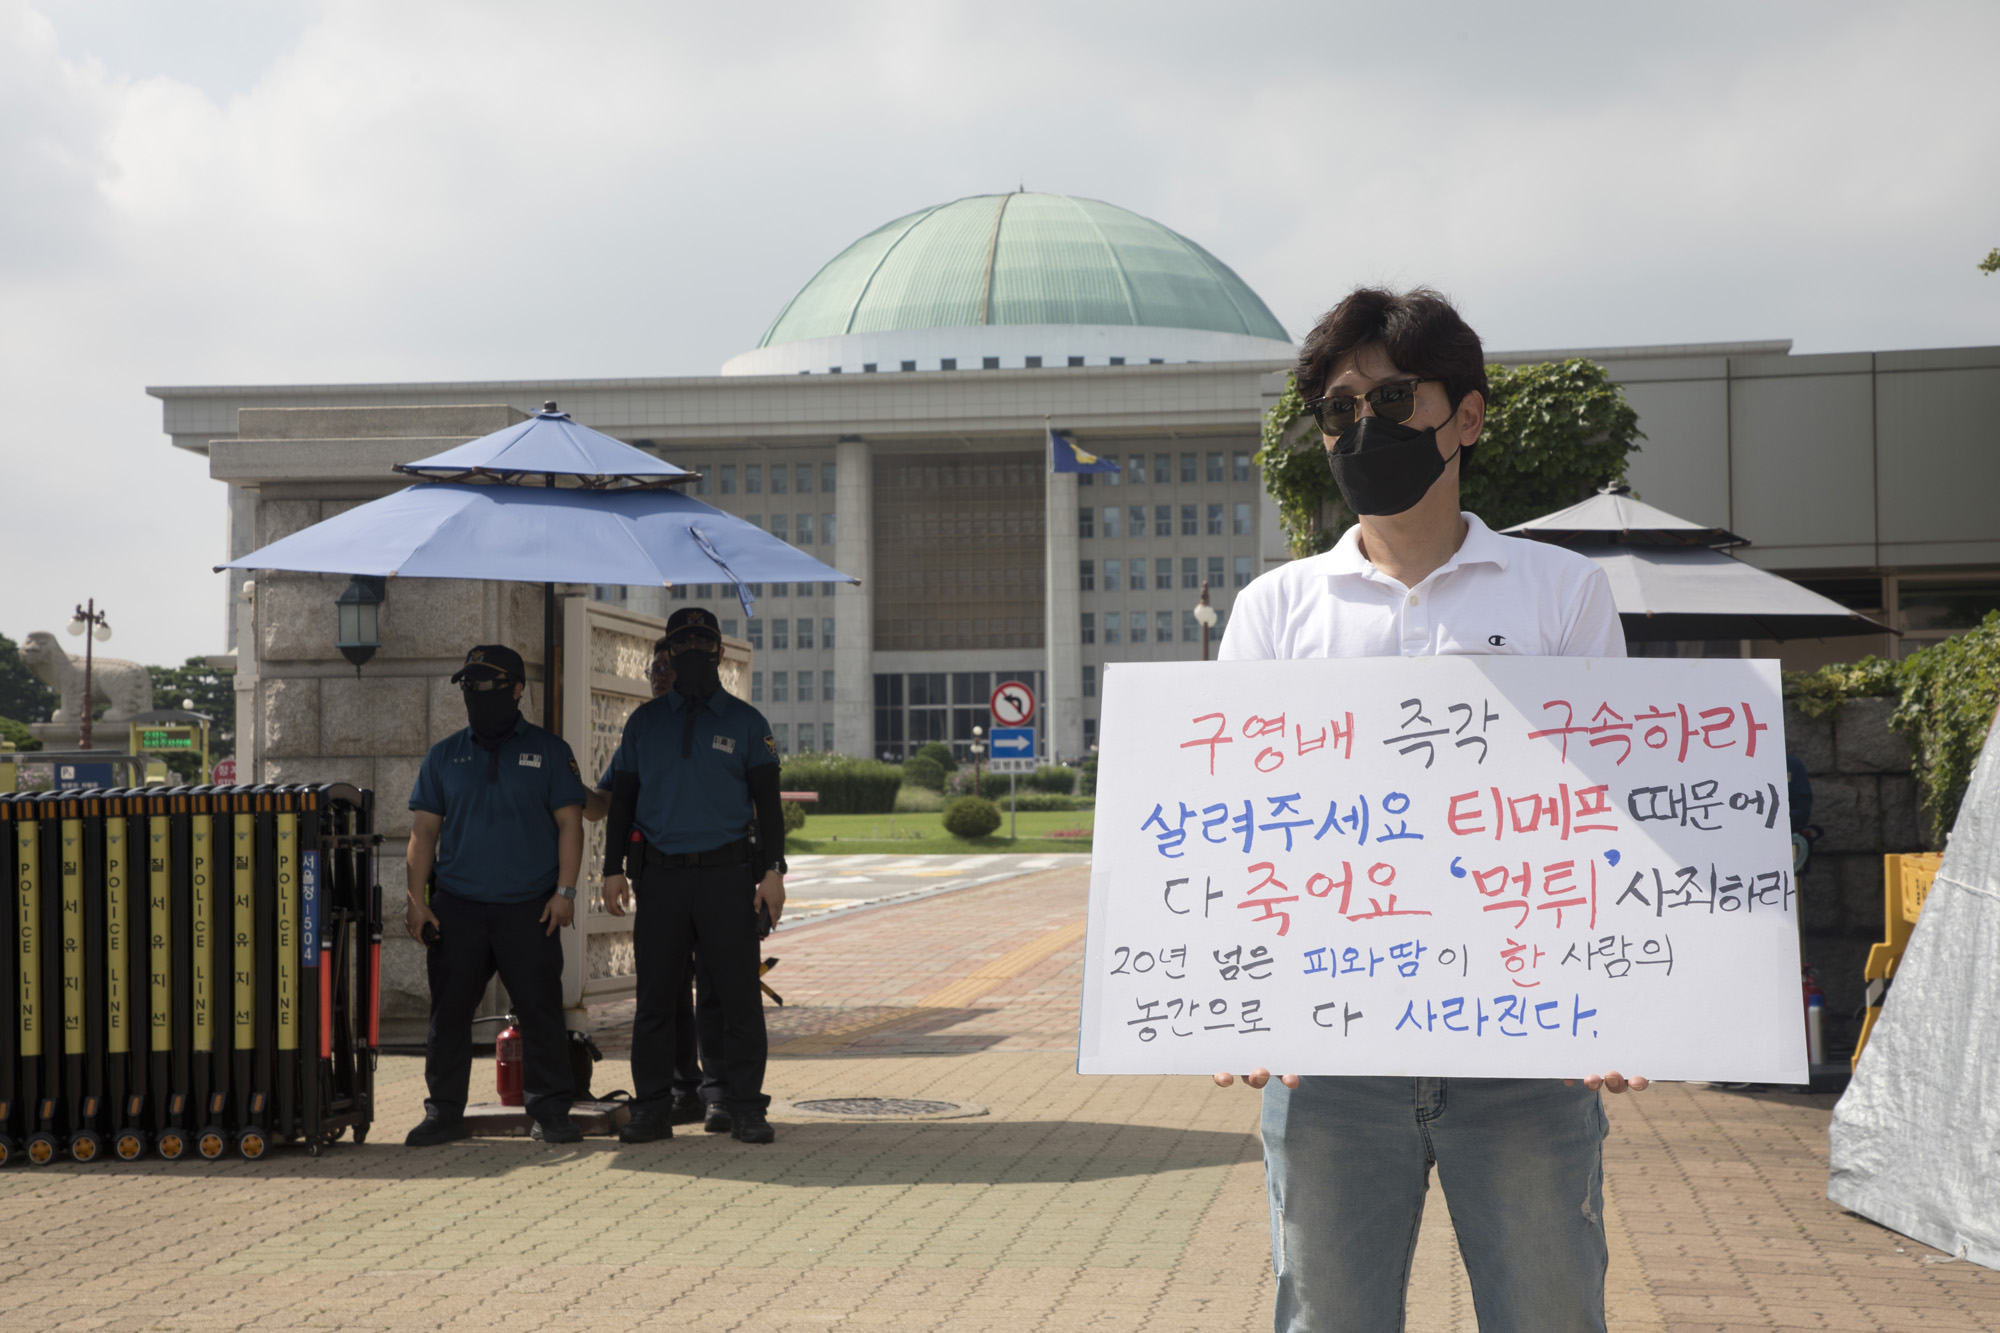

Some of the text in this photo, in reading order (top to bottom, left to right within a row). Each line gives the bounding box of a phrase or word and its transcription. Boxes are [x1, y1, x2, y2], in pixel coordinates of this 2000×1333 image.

[1140, 780, 1781, 859] 살려주세요 티메프 때문에
[1180, 698, 1768, 775] 구영배 즉각 구속하라
[20, 863, 33, 1032] POLICE LINE
[63, 861, 79, 1030] 질서유지선
[108, 859, 121, 1029] POLICE LINE
[151, 858, 166, 1028] 질서유지선
[194, 857, 206, 1027] POLICE LINE
[235, 856, 250, 1026] 질서유지선
[279, 856, 291, 1026] POLICE LINE
[1110, 944, 1187, 979] 20년
[1213, 944, 1274, 981] 넘은
[1500, 937, 1546, 988] 한
[1560, 934, 1674, 979] 사람의
[1164, 876, 1223, 918] 다
[1237, 861, 1432, 937] 죽어요
[1616, 863, 1796, 918] 사죄하라
[1127, 994, 1598, 1042] 농간으로 다 사라진다.
